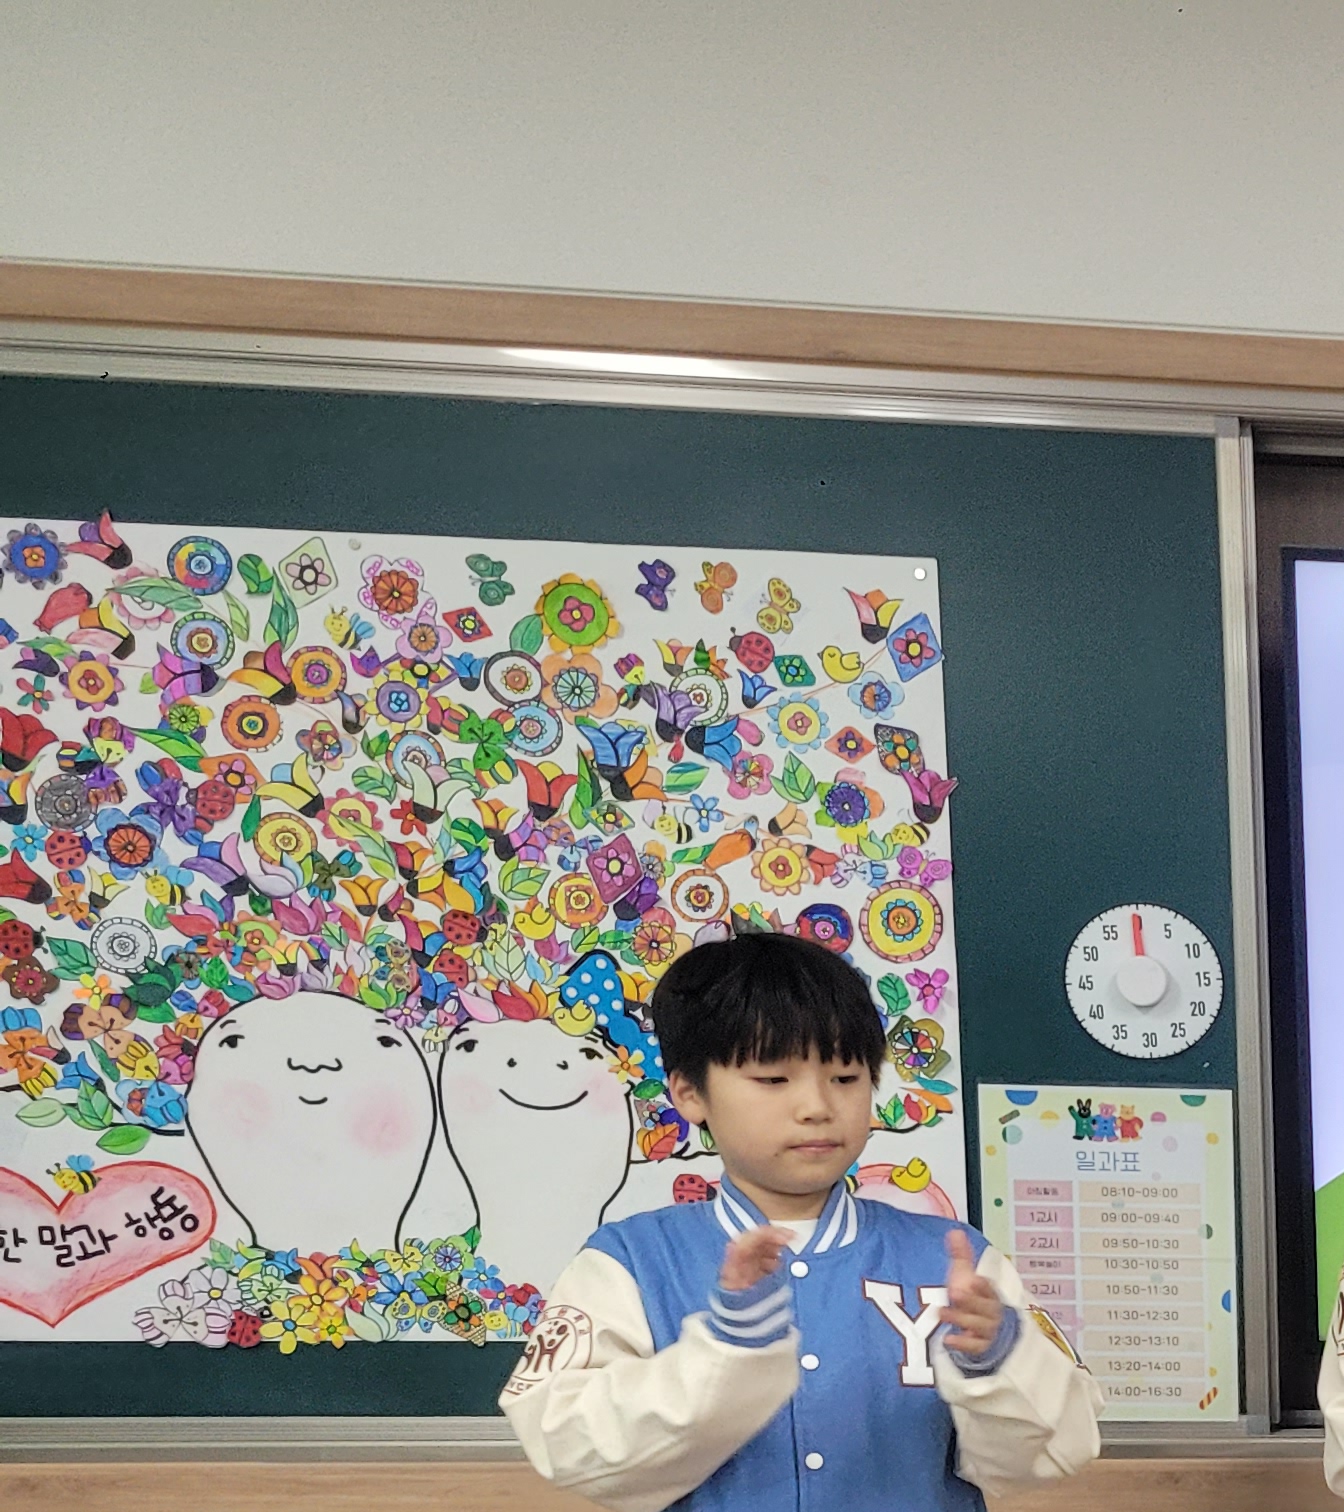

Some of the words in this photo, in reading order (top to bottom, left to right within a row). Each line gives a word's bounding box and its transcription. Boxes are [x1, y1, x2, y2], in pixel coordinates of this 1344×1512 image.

[1103, 925, 1118, 940] 55
[1164, 924, 1171, 939] 5
[1083, 946, 1099, 961] 50
[1185, 943, 1200, 958] 10
[1078, 975, 1094, 990] 45
[1195, 971, 1211, 987] 15
[1089, 1004, 1104, 1019] 40
[1190, 1001, 1206, 1017] 20
[1112, 1024, 1128, 1040] 35
[1170, 1022, 1186, 1038] 25
[1142, 1032, 1157, 1048] 30
[1076, 1150, 1141, 1172] 일과표
[1030, 1211, 1058, 1223] 1교시
[38, 1225, 118, 1268] 말과
[124, 1186, 200, 1241] 행동
[1029, 1237, 1059, 1249] 2교시
[861, 1277, 950, 1388] Y
